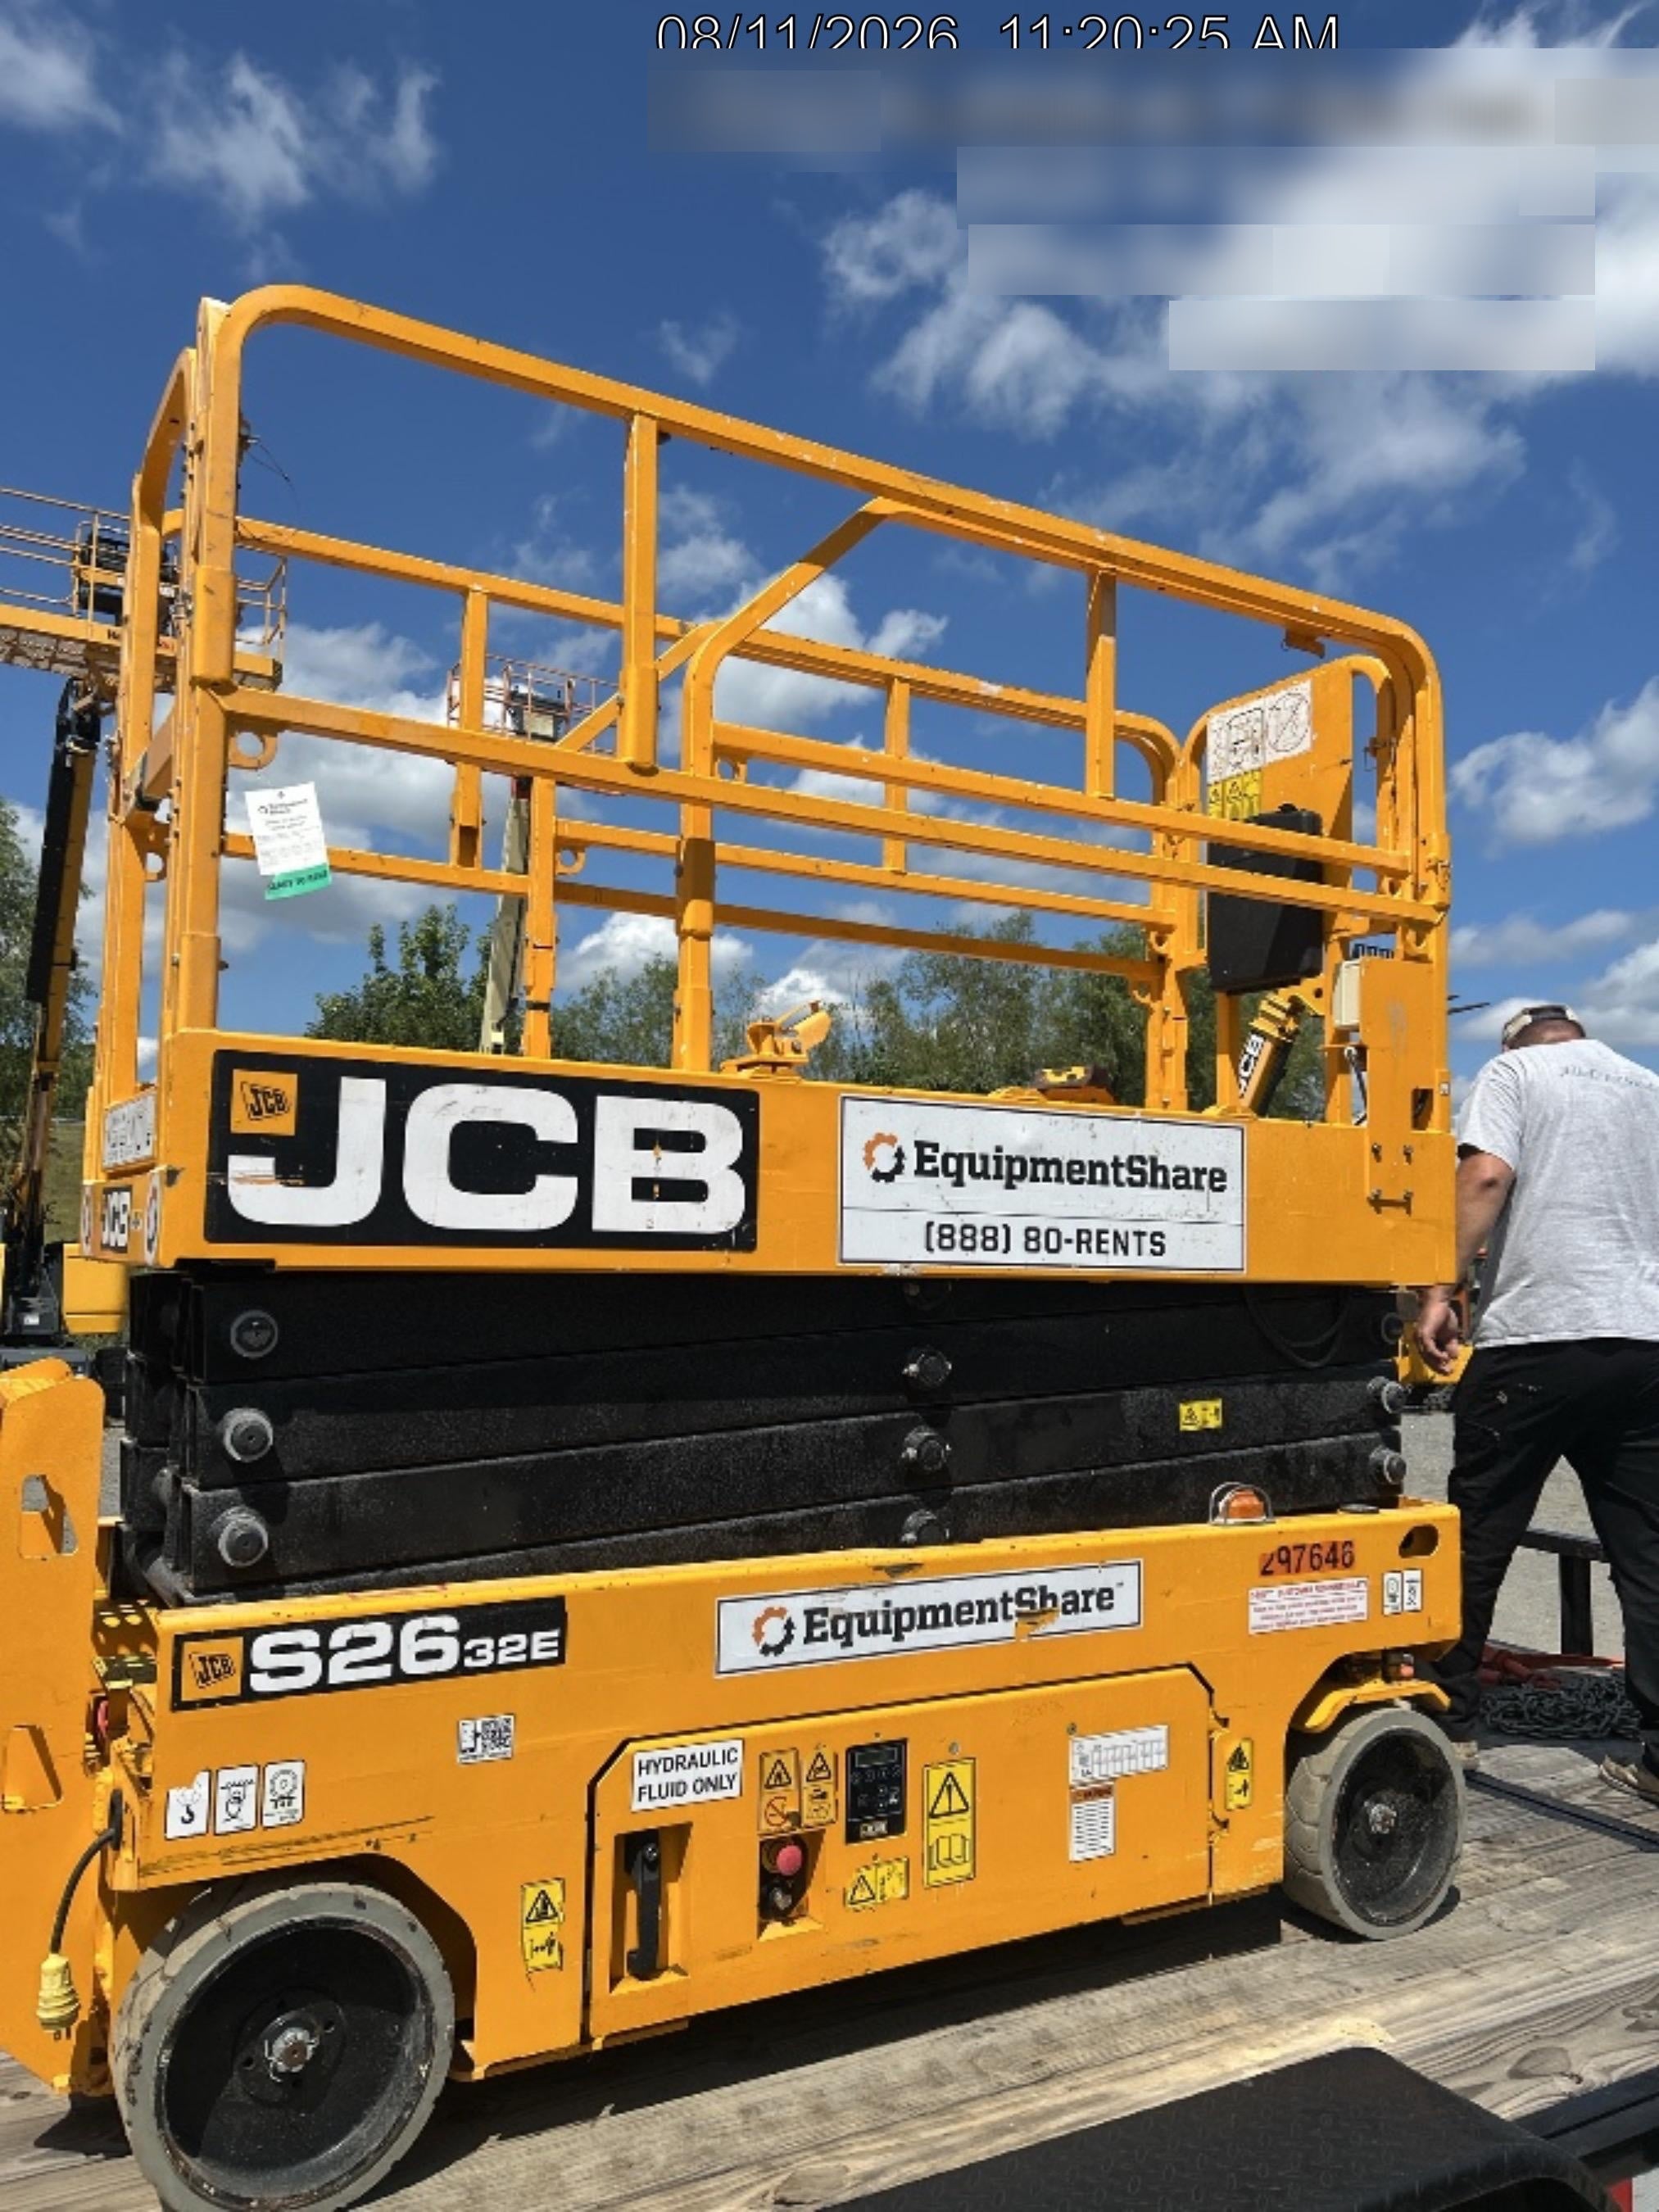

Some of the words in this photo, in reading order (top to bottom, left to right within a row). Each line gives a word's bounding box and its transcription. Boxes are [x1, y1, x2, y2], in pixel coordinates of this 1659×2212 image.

[247, 1084, 288, 1119] JCB
[227, 1077, 746, 1234] JCB
[913, 1140, 1227, 1193] EquipmentShare
[924, 1220, 1012, 1253] (888)
[1024, 1224, 1167, 1256] 80-RENTS
[1260, 1540, 1354, 1575] 297646
[803, 1586, 1116, 1646] EquipmentShare
[197, 1652, 235, 1688] JCB
[638, 1747, 738, 1777] HYDRAULIC
[638, 1779, 688, 1802] FLUID
[691, 1772, 737, 1795] ONLY
